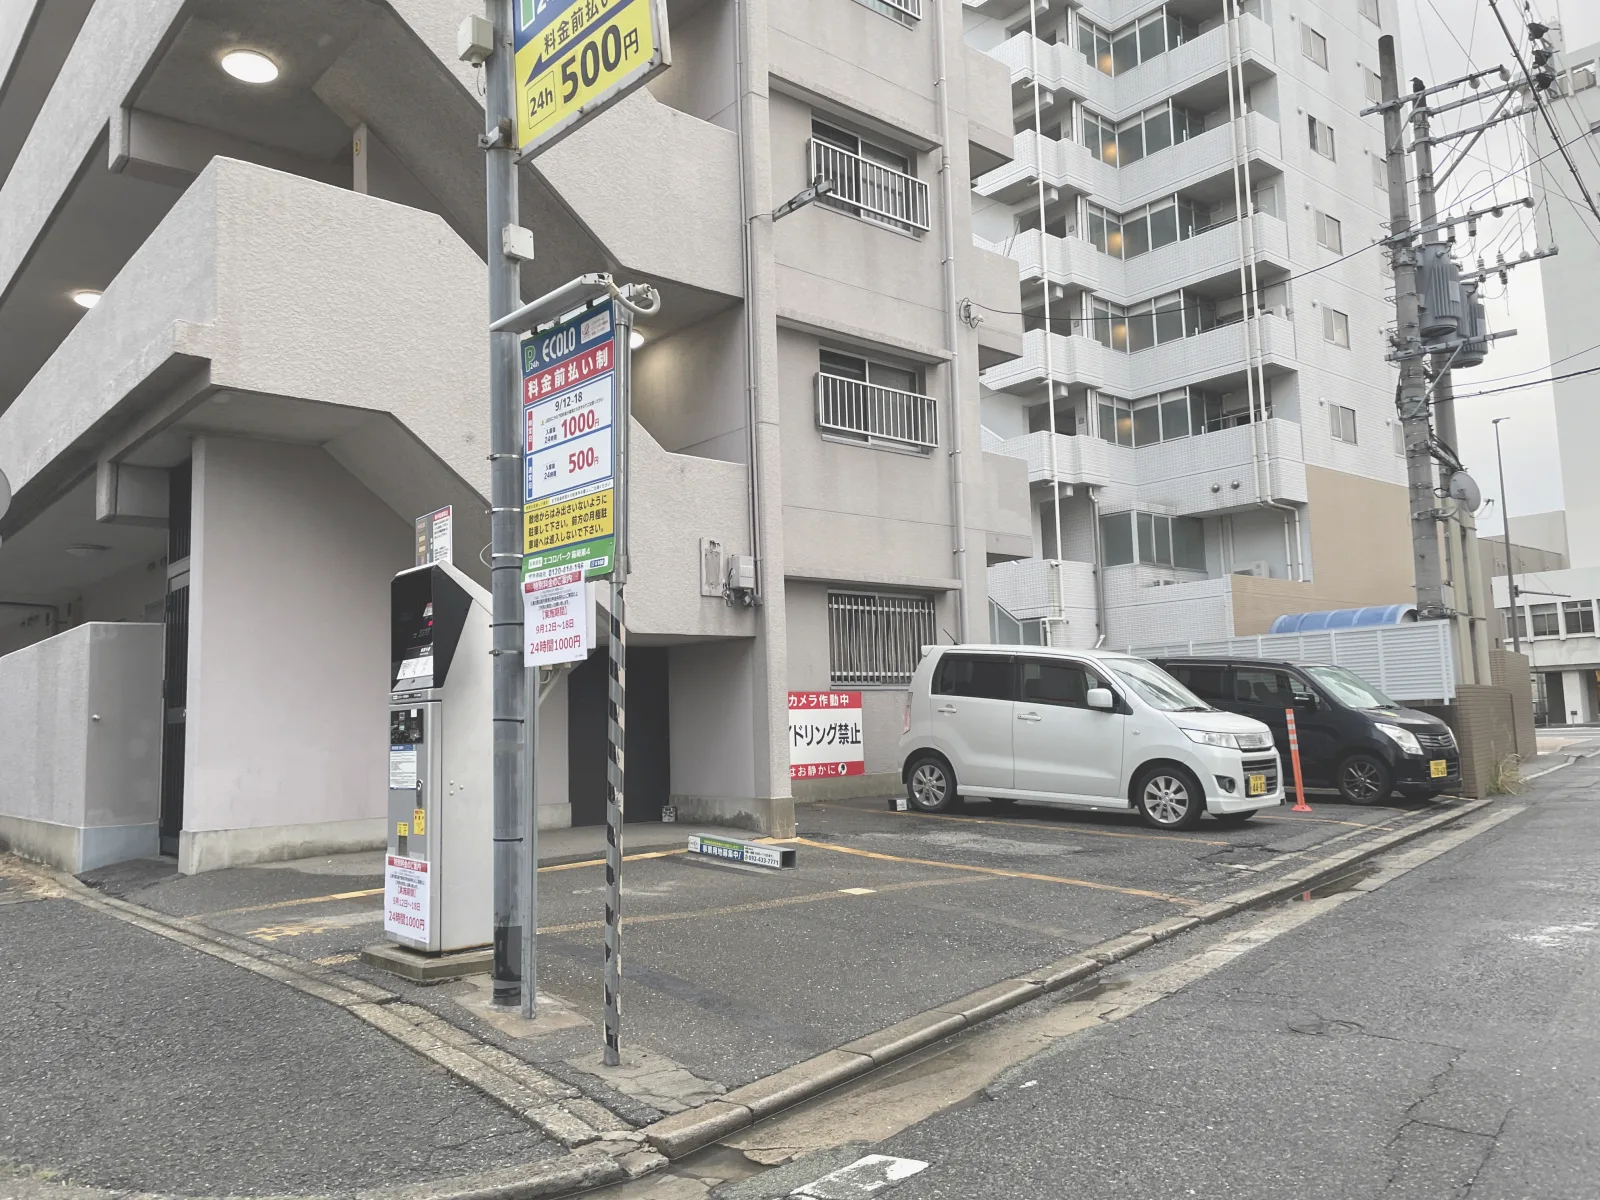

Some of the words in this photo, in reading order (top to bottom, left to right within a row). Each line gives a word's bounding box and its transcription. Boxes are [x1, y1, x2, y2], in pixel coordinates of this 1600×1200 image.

[529, 87, 553, 117] 24h
[561, 24, 639, 104] 500円
[527, 347, 608, 398] 料金前払い制
[561, 409, 600, 438] 1000円
[568, 446, 599, 474] 500円
[530, 634, 581, 654] 24時間1000円
[788, 693, 849, 707] カメラ作動中
[788, 722, 862, 747] ドリング禁止
